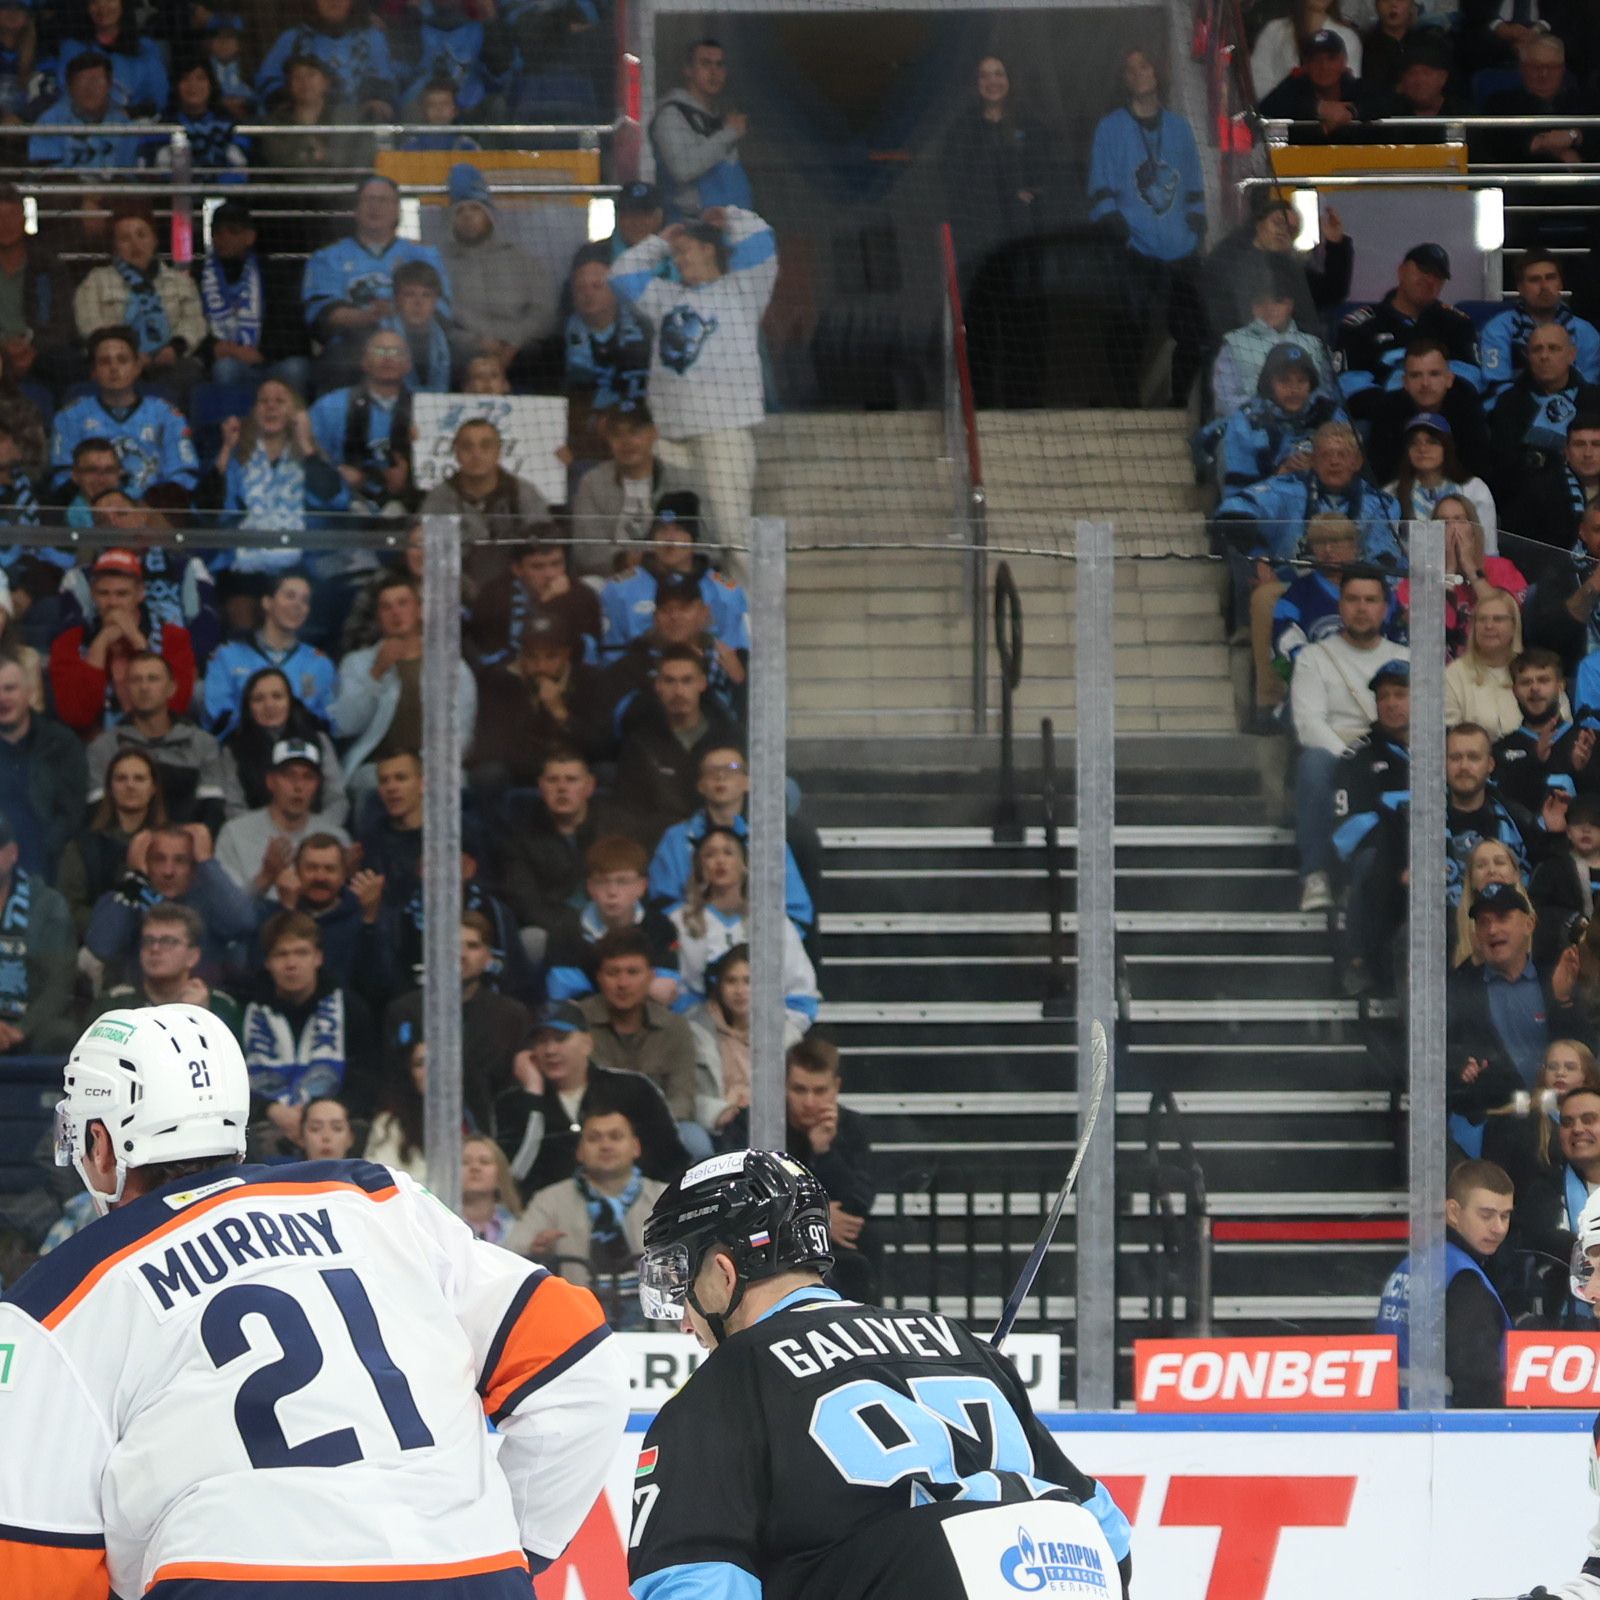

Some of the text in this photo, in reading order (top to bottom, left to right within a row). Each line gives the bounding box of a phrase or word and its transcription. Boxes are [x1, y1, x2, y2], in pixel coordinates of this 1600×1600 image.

[84, 1087, 112, 1097] CCM
[188, 1059, 211, 1089] 21
[682, 1155, 745, 1187] Belavia
[678, 1204, 719, 1224] BAUER
[808, 1223, 830, 1253] 97
[138, 1208, 343, 1311] MURRAY
[768, 1315, 961, 1379] GALIYEV
[200, 1268, 435, 1470] 21
[1140, 1349, 1393, 1401] FONBET
[1511, 1344, 1600, 1394] FO
[809, 1376, 1067, 1508] 97
[1038, 1542, 1103, 1571] ГАЗПРОМ
